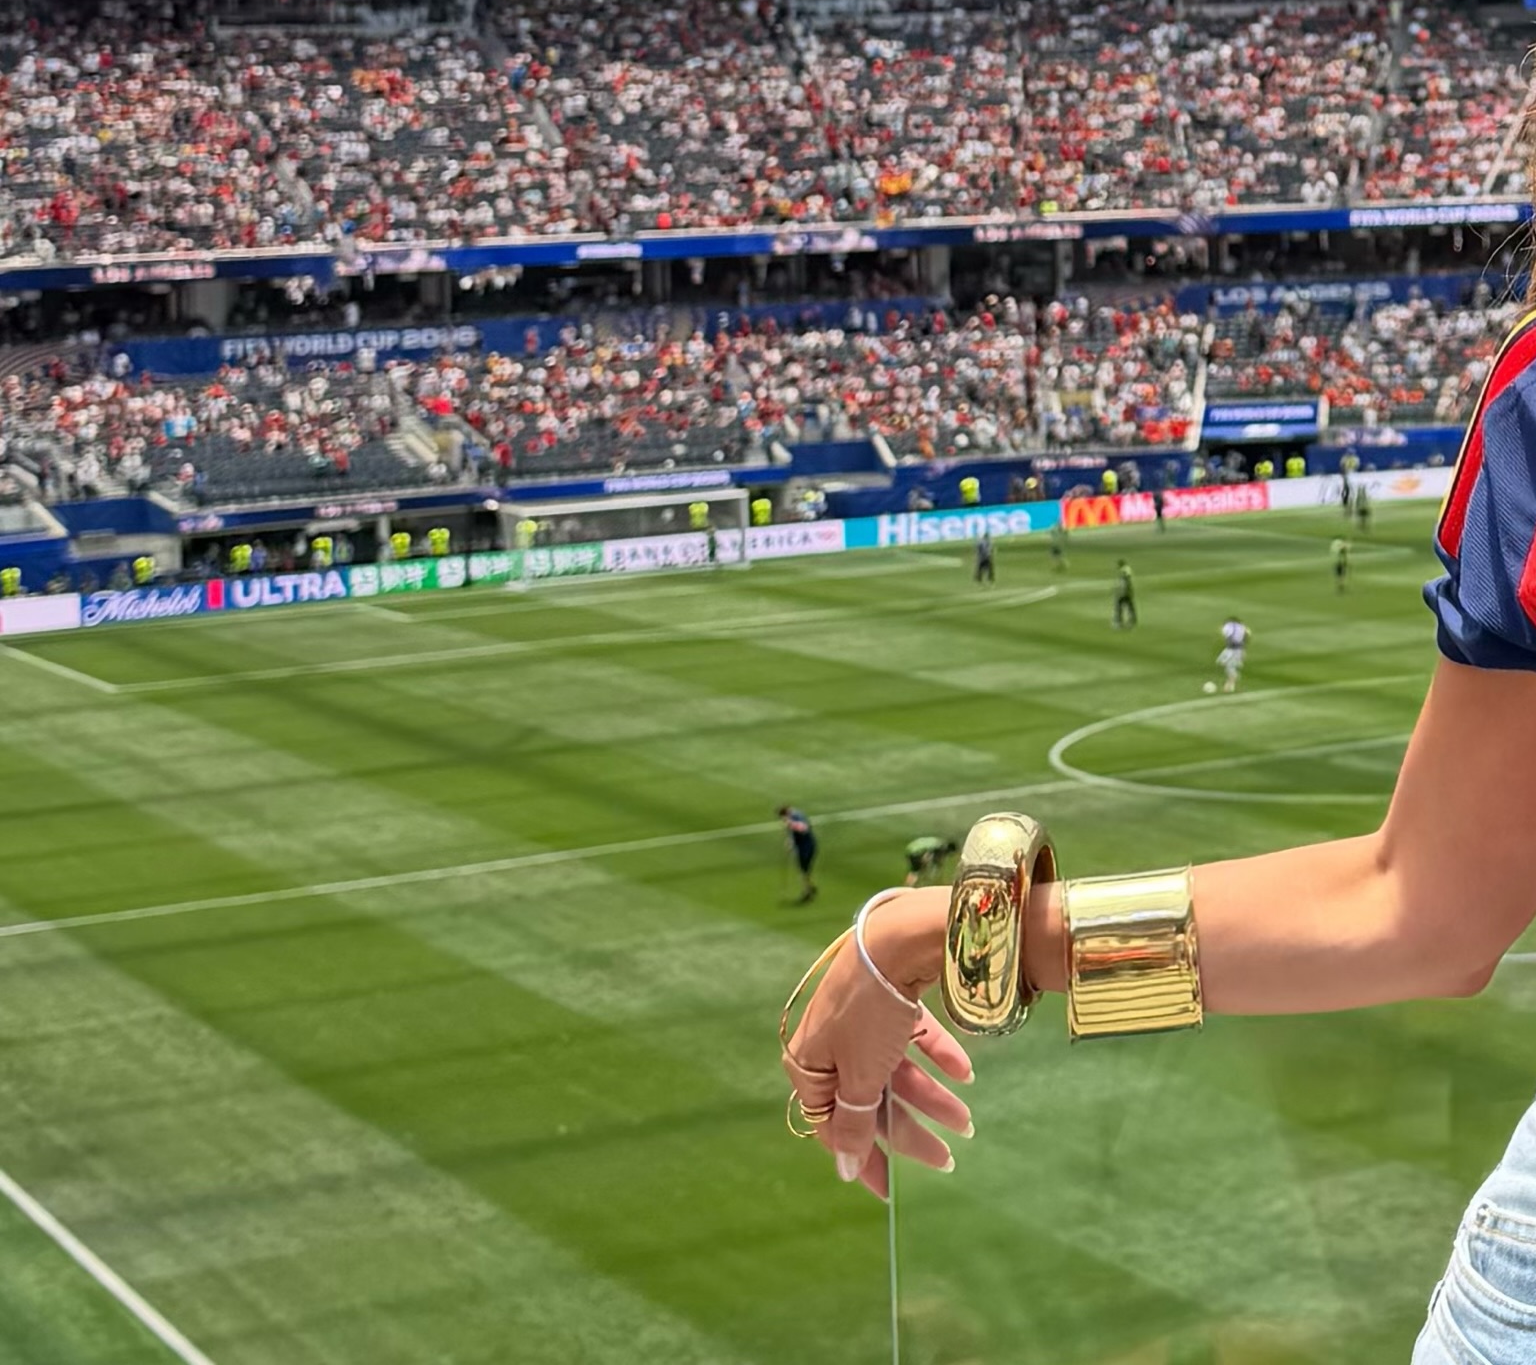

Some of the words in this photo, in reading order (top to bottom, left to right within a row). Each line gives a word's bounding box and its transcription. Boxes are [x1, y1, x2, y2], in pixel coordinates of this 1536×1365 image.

[355, 330, 399, 352] CUP
[877, 508, 1031, 546] Hisense
[230, 571, 346, 608] ULTRA
